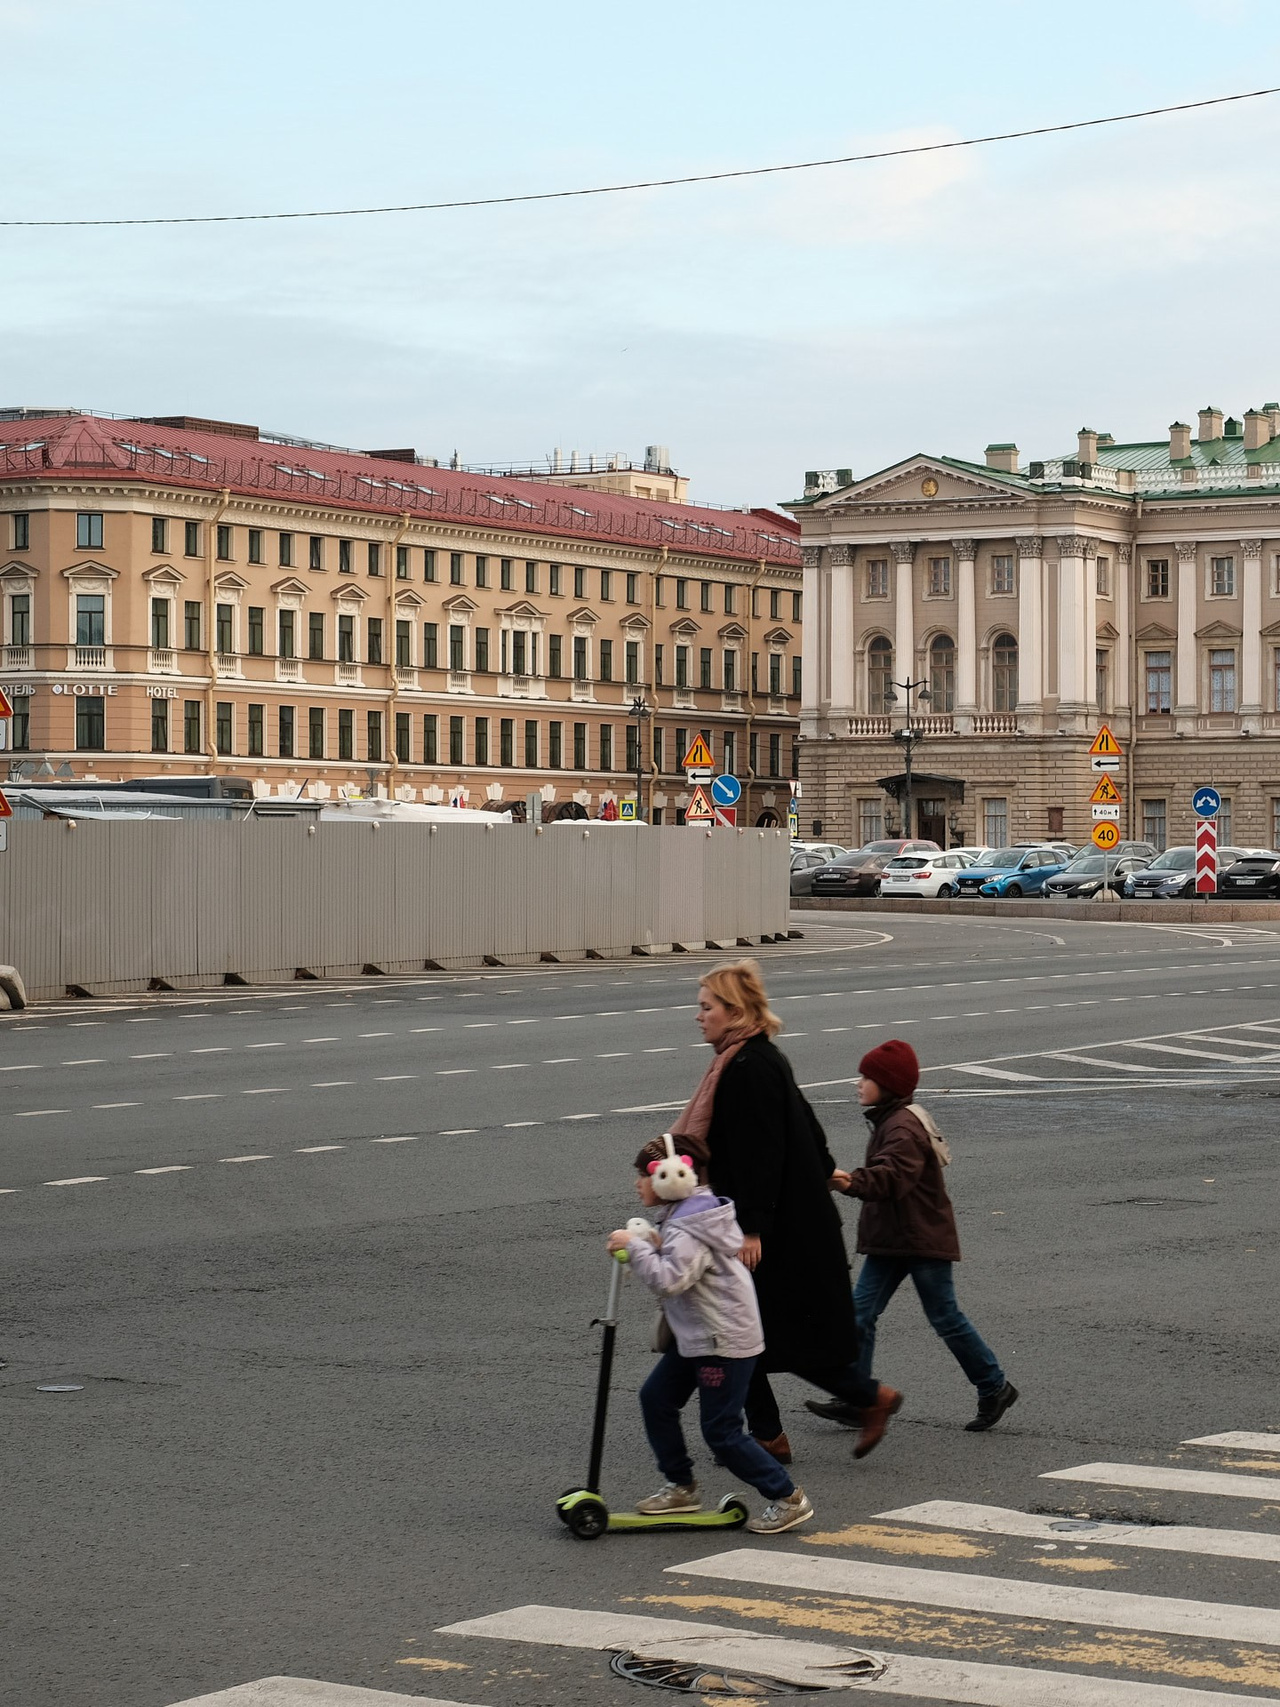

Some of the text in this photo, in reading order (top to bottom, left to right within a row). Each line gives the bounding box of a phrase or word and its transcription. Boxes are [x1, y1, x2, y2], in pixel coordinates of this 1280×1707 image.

[64, 684, 118, 696] LOTTE
[147, 686, 179, 698] HOTEL
[1098, 830, 1114, 841] 40
